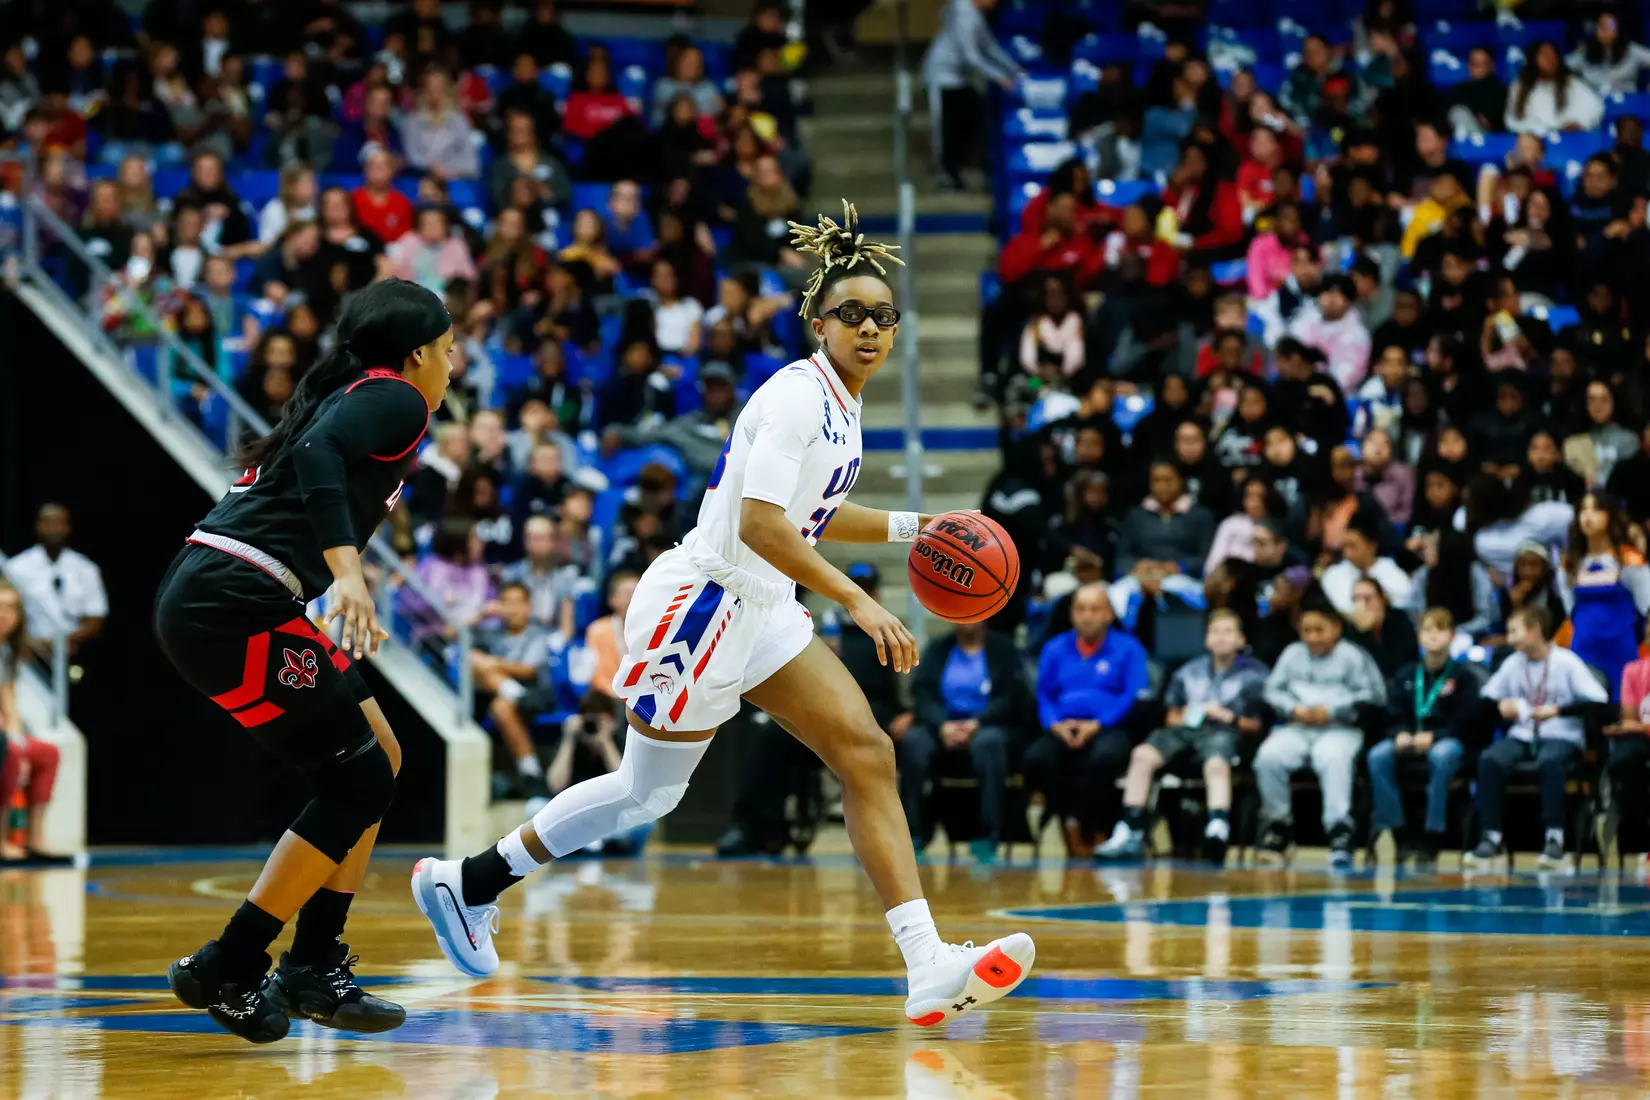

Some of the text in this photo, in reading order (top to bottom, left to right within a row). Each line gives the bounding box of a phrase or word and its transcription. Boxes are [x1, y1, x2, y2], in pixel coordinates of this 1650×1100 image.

[892, 515, 910, 539] HARD
[937, 519, 988, 553] NCAA
[915, 538, 975, 589] Wilson
